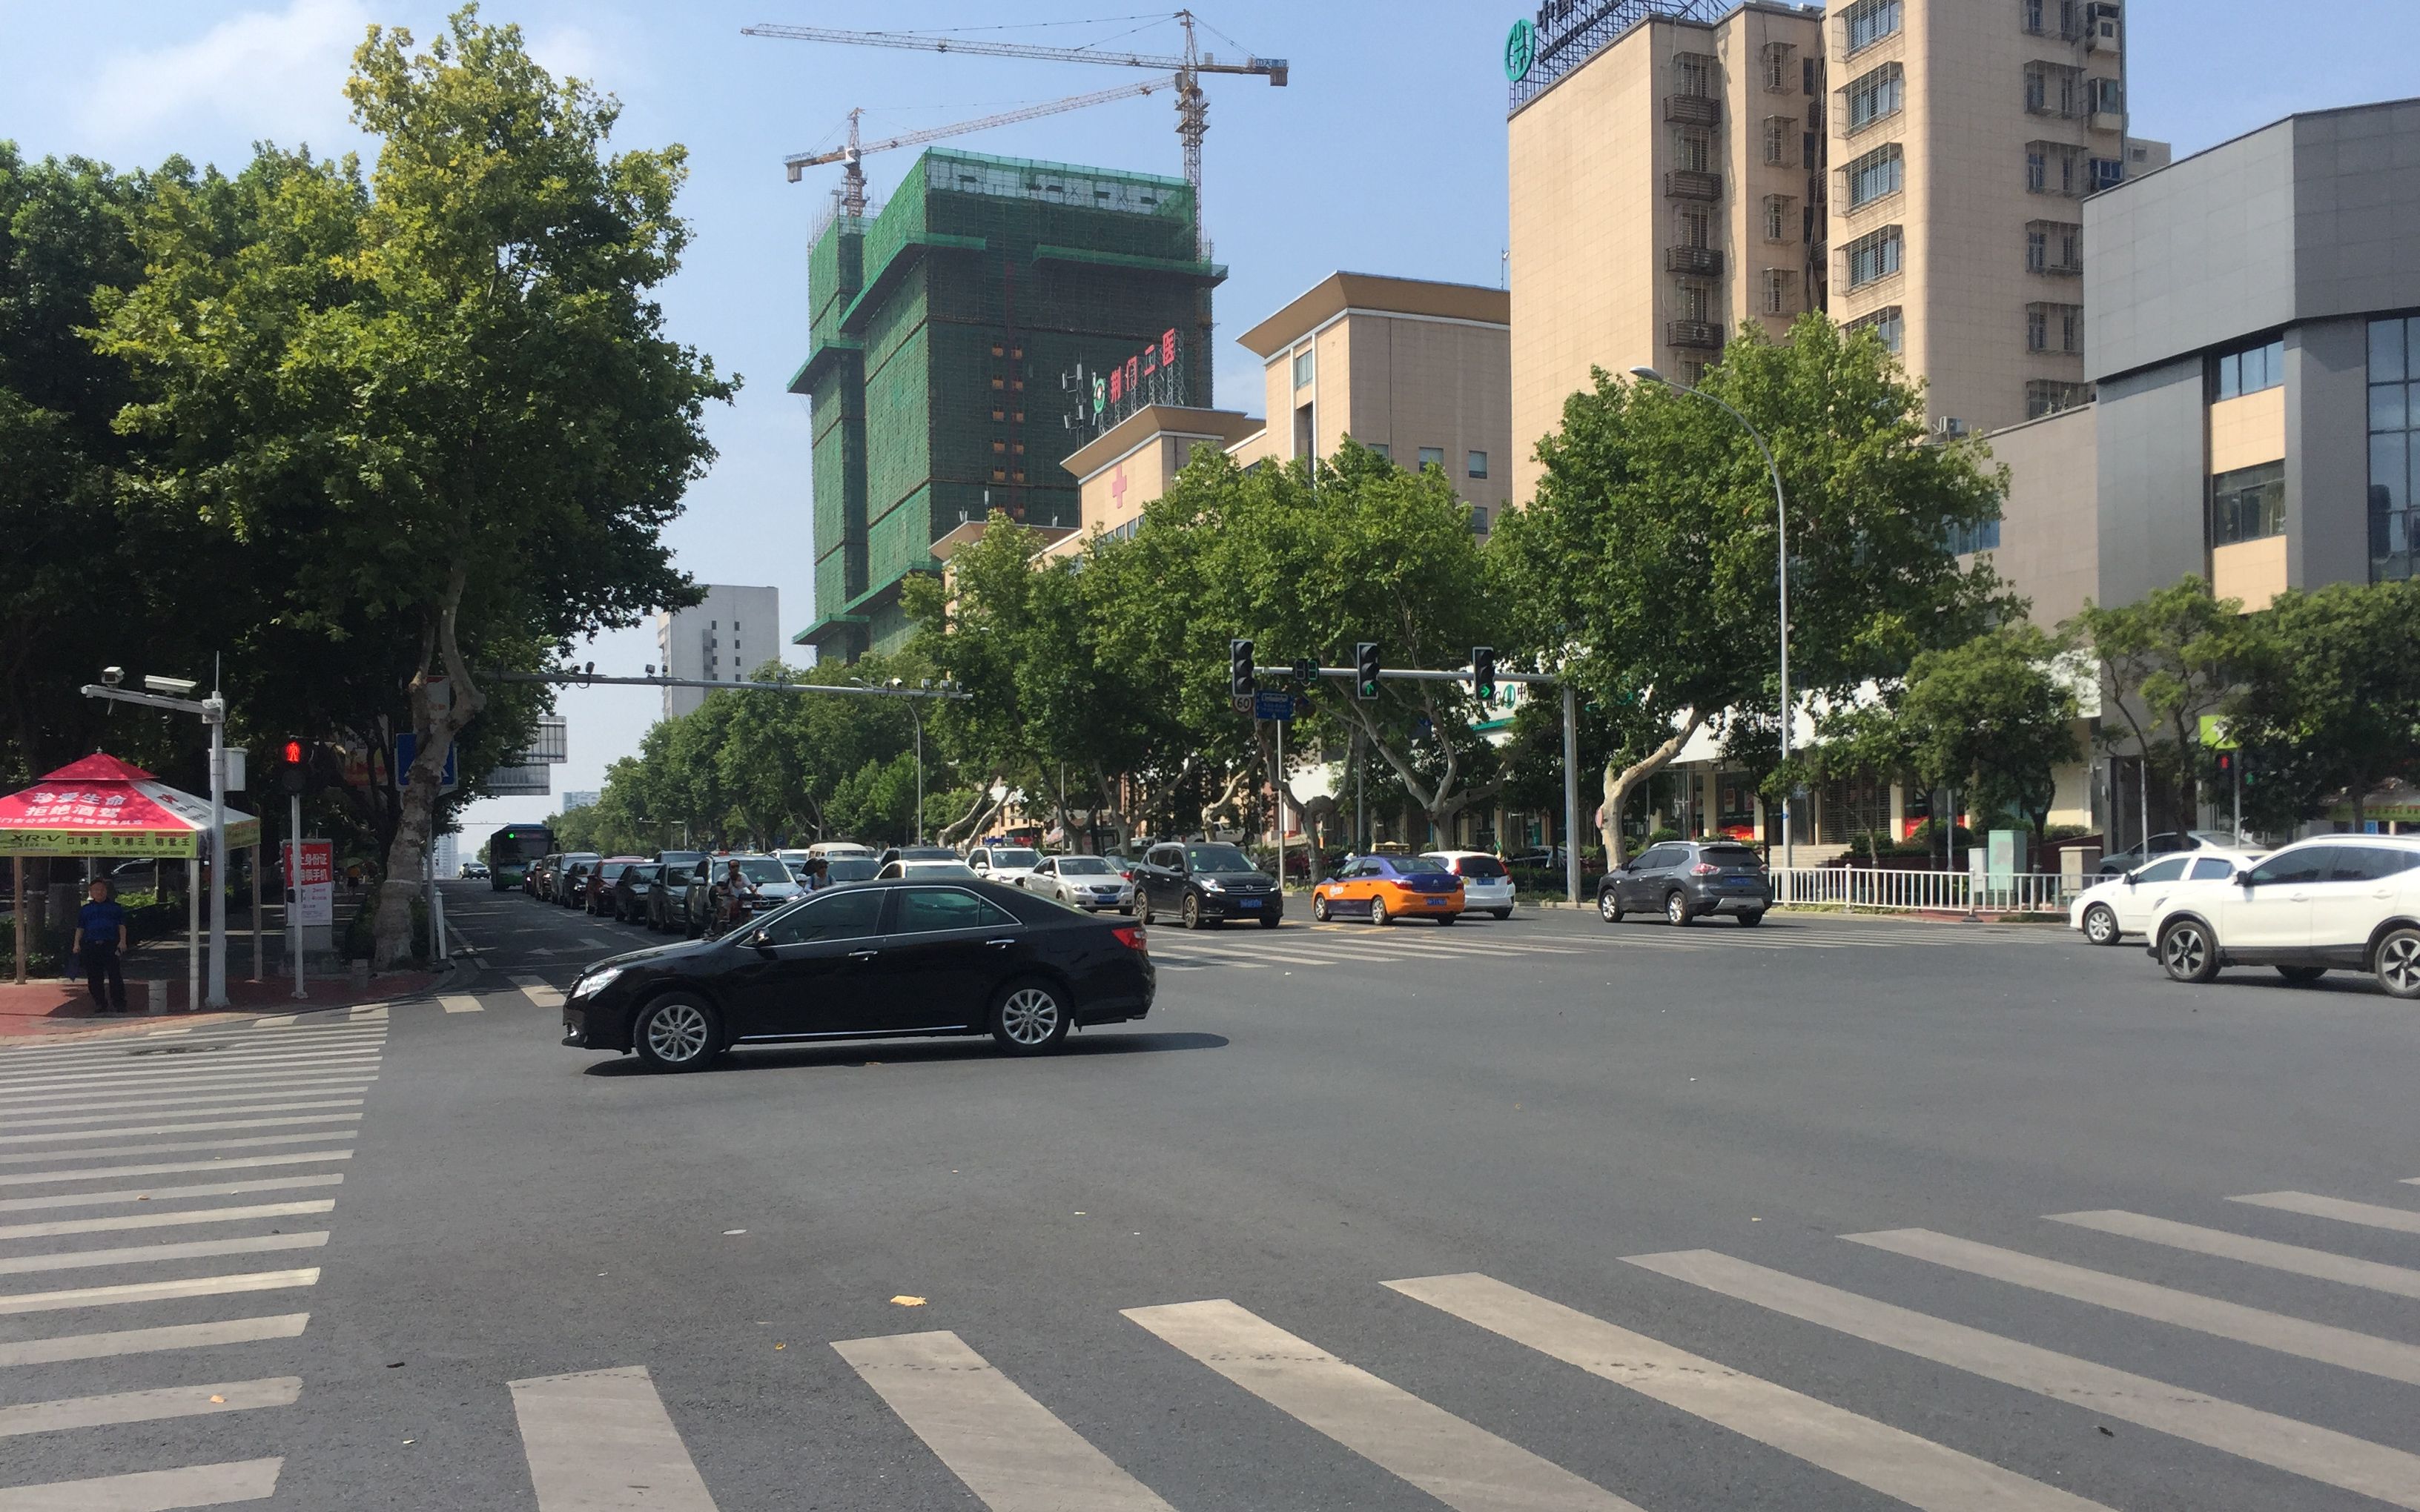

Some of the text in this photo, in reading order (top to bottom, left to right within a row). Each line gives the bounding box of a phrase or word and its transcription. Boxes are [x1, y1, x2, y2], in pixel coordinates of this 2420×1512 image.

[1111, 328, 1175, 404] 荆门二医
[1237, 699, 1250, 709] 60
[33, 792, 127, 806] 珍爱生命
[25, 804, 121, 818] 拒绝酒驾
[290, 853, 328, 866] 上身份证
[291, 869, 328, 881] 用领手机
